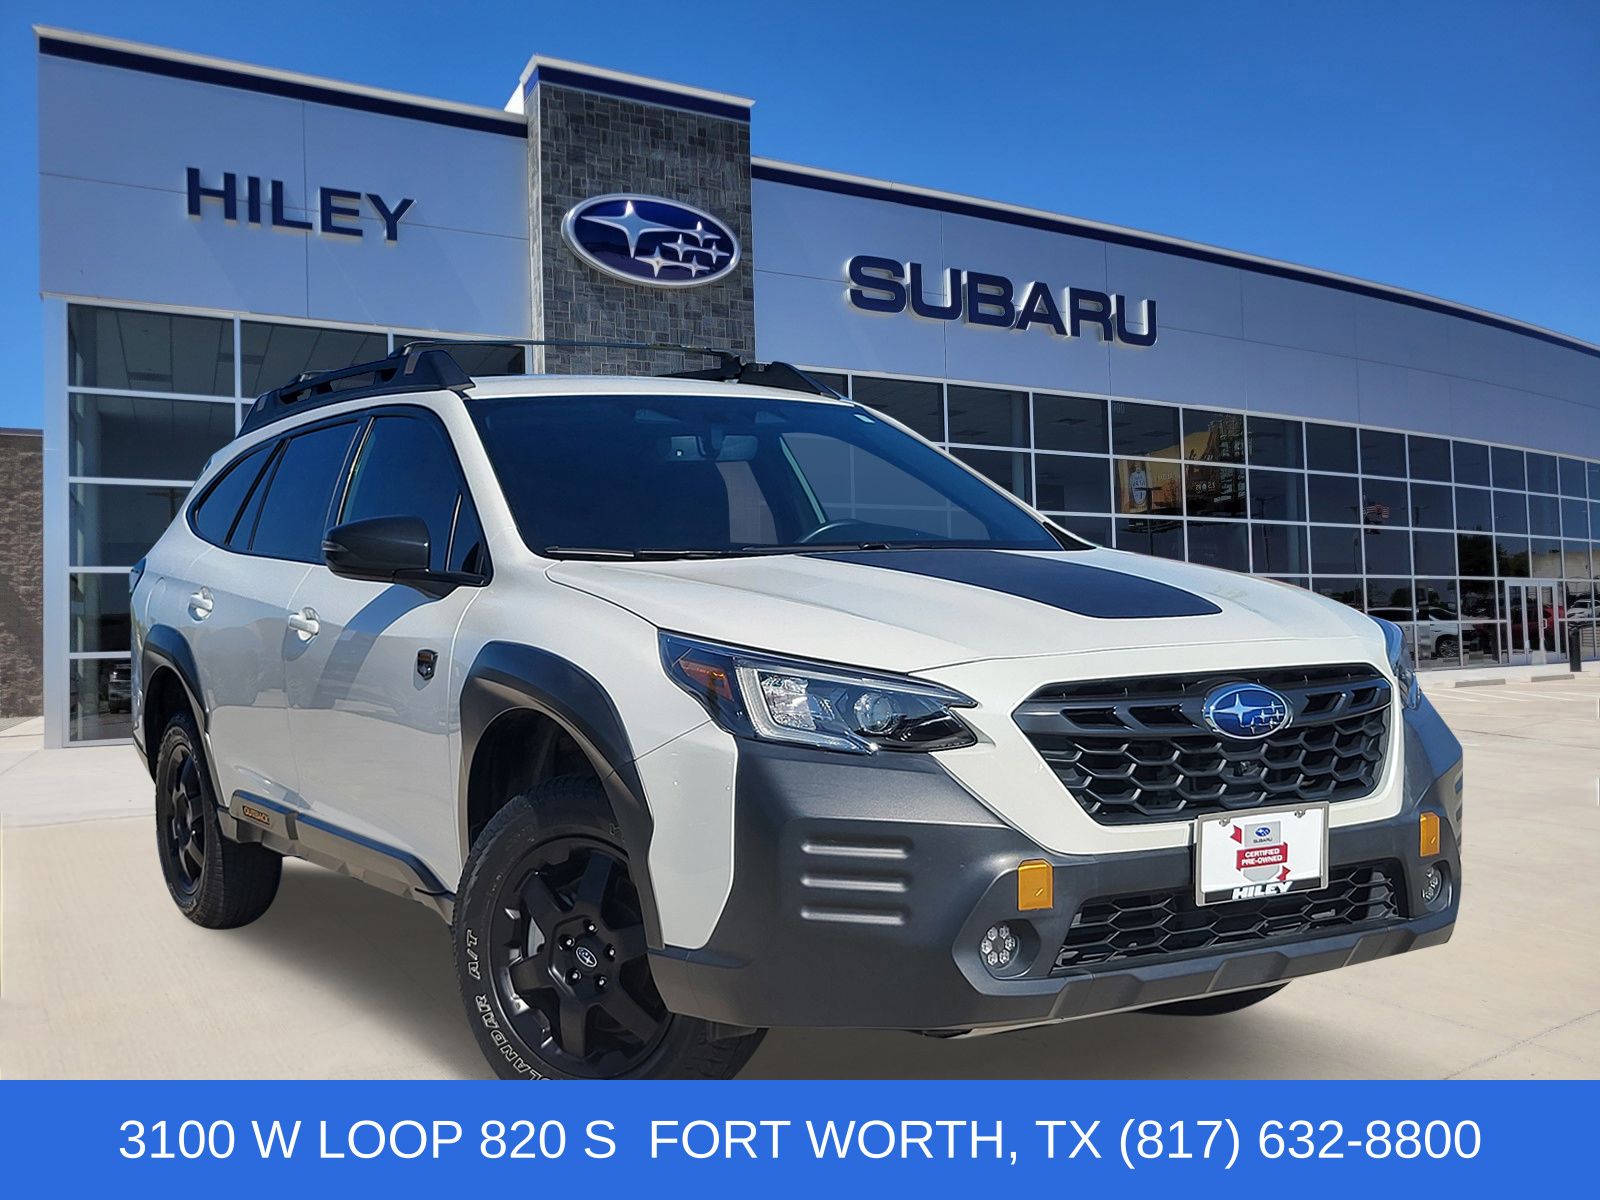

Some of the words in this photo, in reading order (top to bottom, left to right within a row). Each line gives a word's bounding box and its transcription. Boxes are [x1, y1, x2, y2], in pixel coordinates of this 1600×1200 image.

[187, 166, 416, 242] HILEY
[847, 254, 1159, 348] SUBARU
[243, 806, 270, 823] OUTBACK
[1241, 854, 1283, 866] PRE-OWNED
[1245, 847, 1280, 859] CERTIFIED
[1232, 881, 1293, 901] HILEY
[467, 929, 481, 980] A/T
[475, 993, 551, 1080] LANDAR
